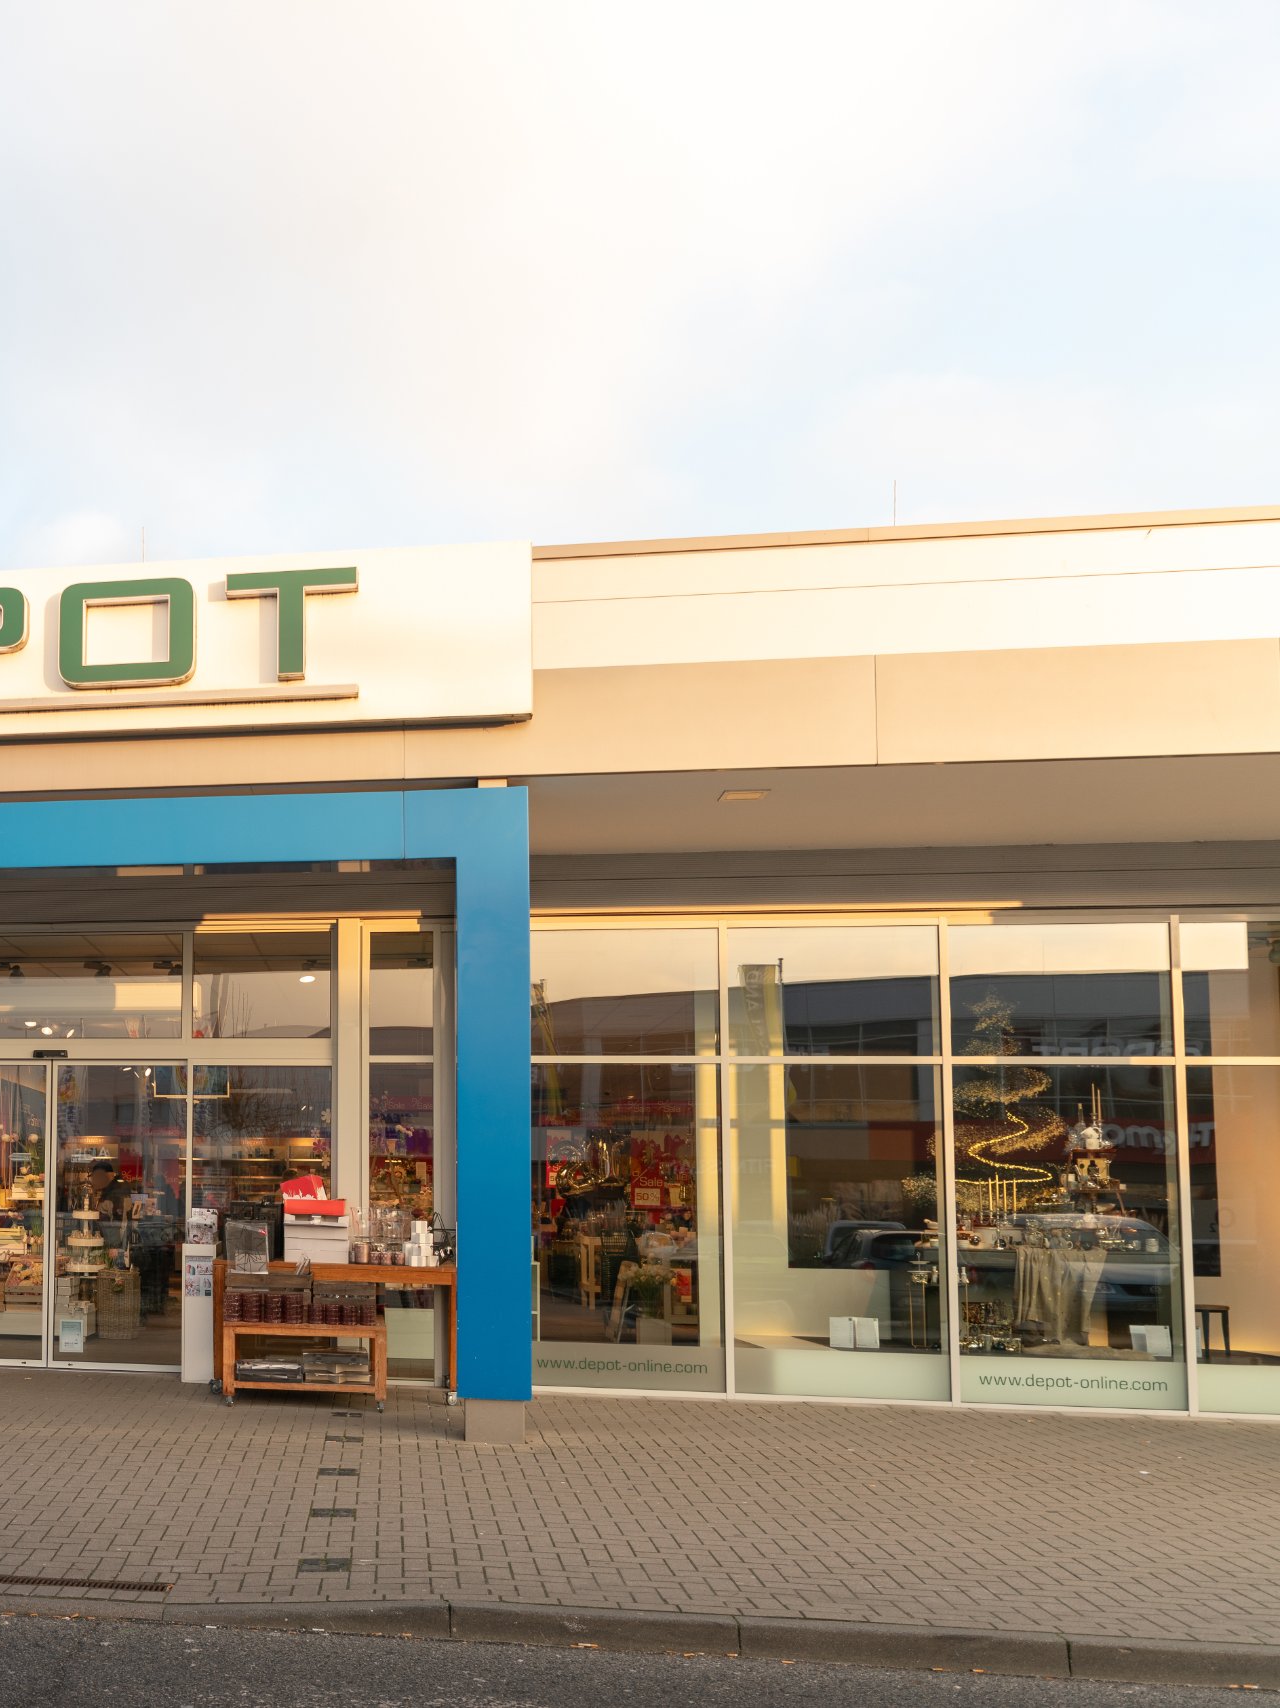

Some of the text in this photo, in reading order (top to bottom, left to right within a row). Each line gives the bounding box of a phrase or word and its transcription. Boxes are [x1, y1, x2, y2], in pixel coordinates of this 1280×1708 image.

[639, 1176, 663, 1187] Sale
[537, 1357, 708, 1374] www.depot-online.com
[979, 1374, 1168, 1391] www.depot-online.com
